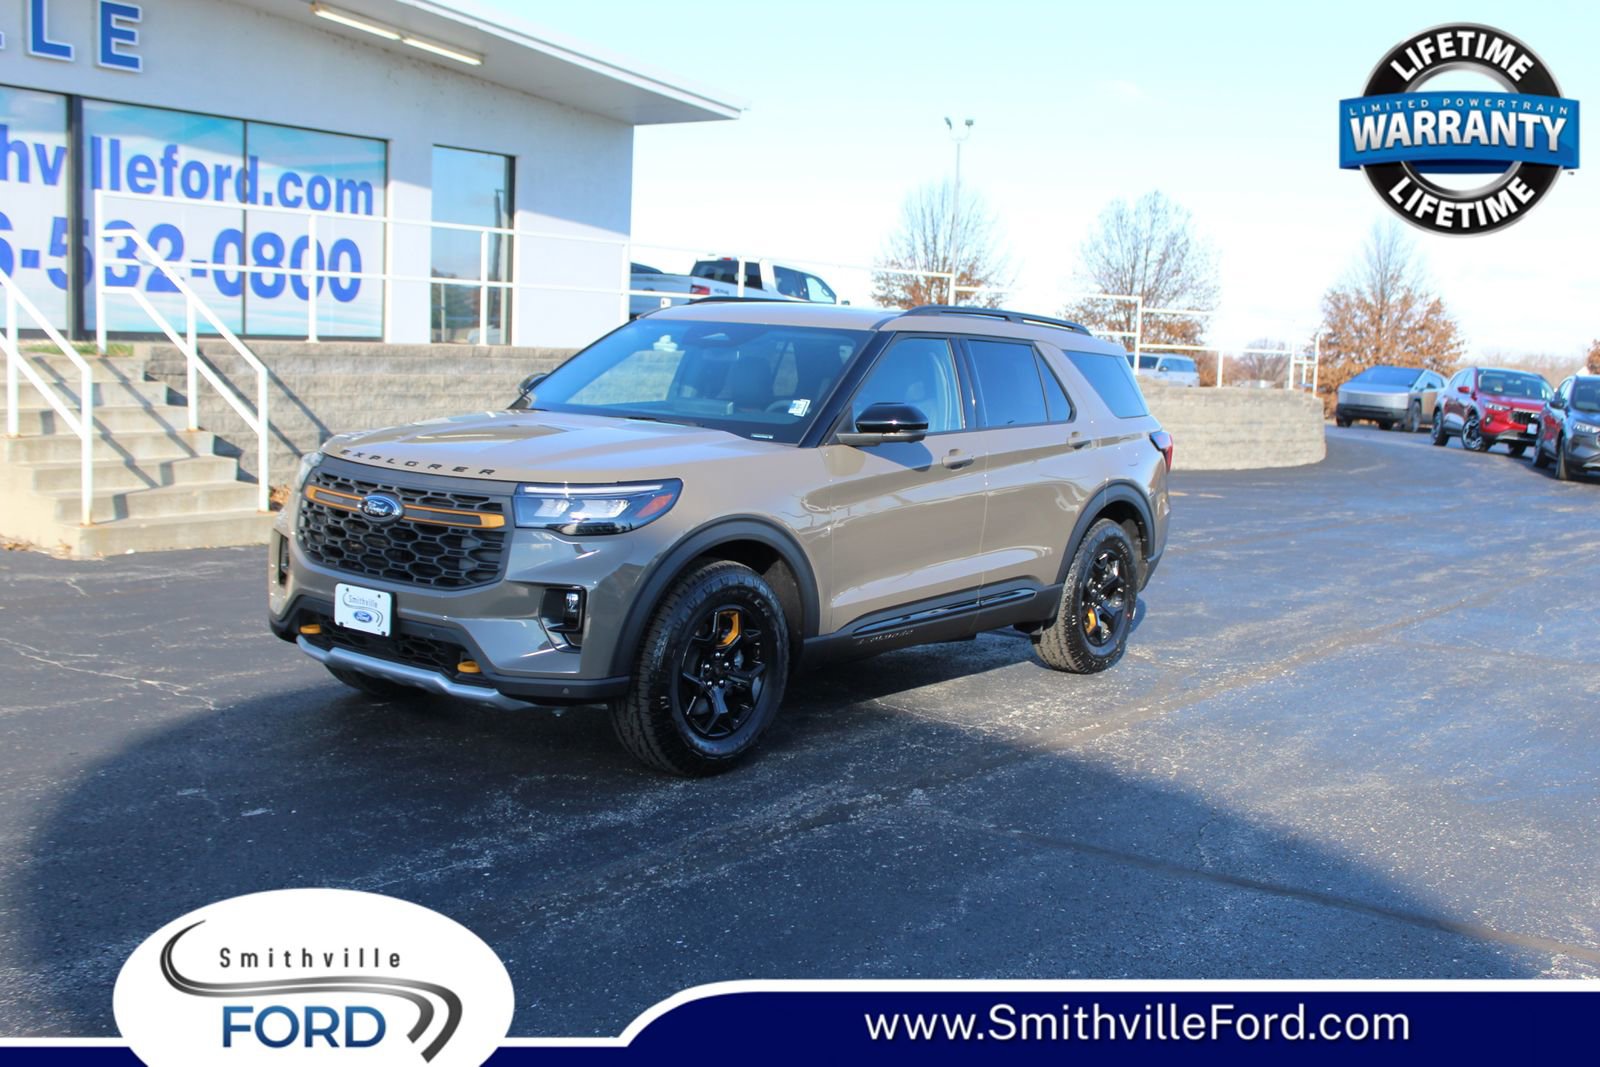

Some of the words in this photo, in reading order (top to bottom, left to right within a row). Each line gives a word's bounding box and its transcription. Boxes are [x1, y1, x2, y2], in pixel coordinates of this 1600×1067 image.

[0, 0, 142, 73] LE
[0, 124, 373, 216] hvlleford.com
[339, 449, 496, 476] EXPLORER
